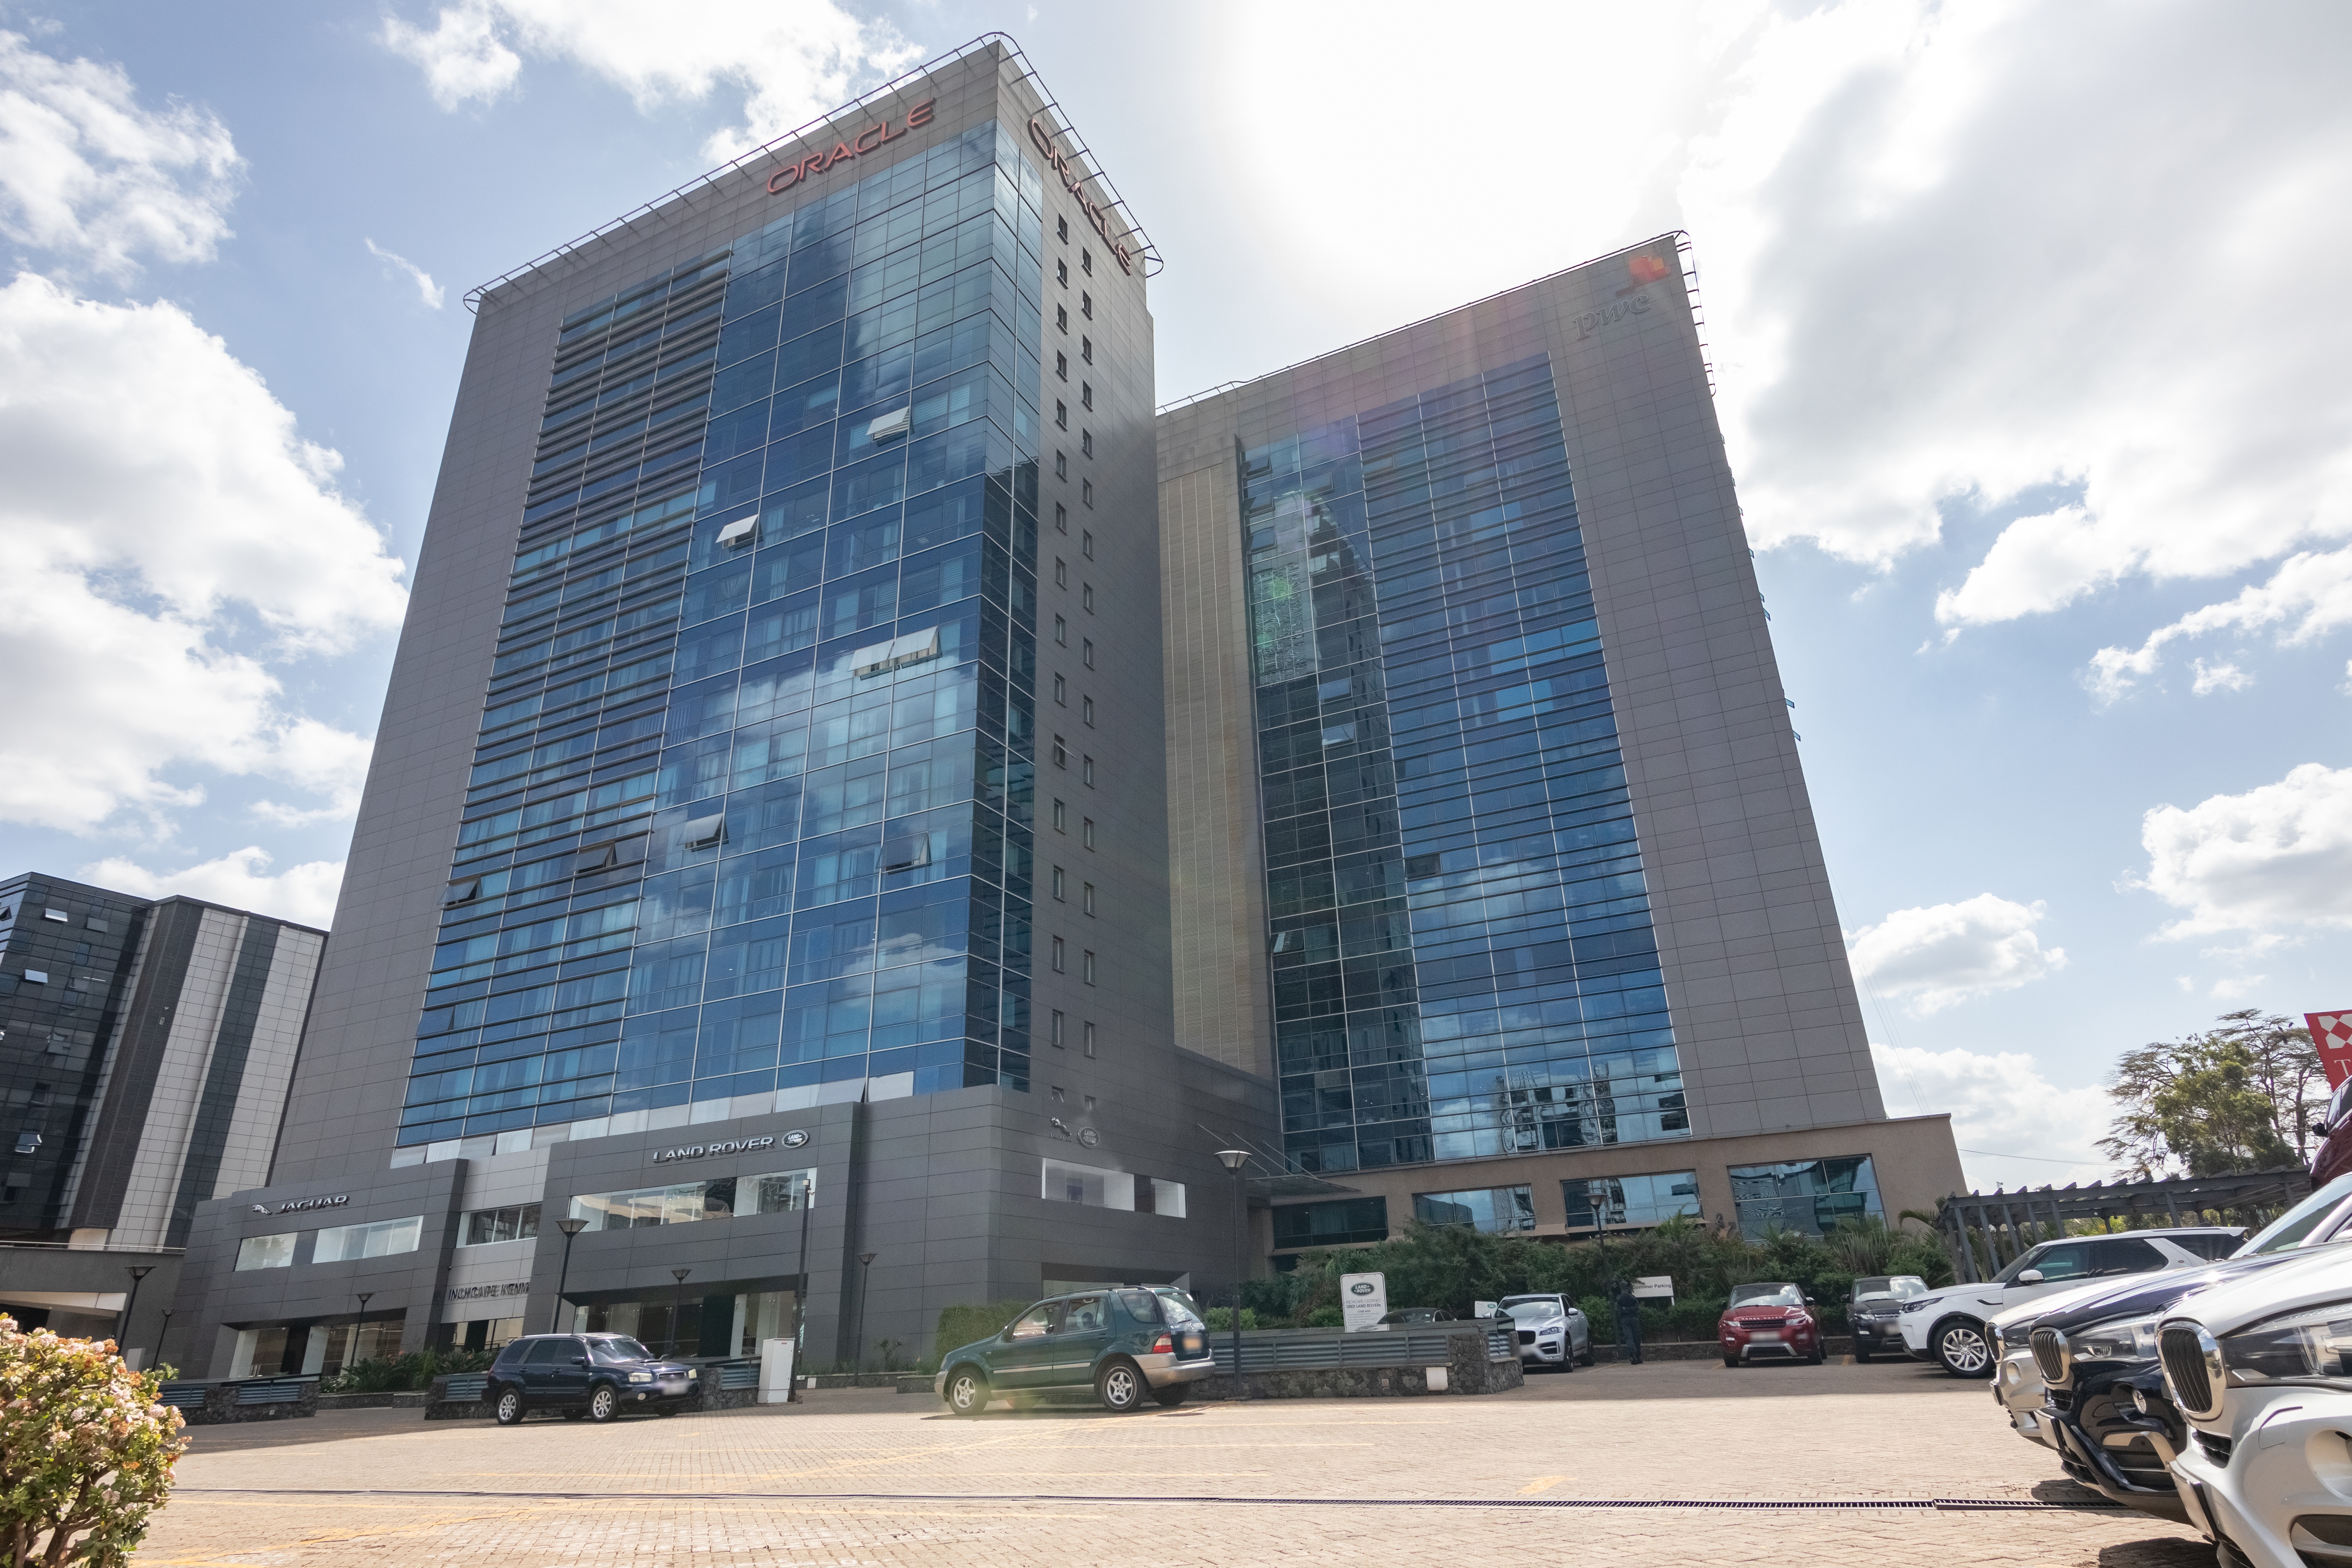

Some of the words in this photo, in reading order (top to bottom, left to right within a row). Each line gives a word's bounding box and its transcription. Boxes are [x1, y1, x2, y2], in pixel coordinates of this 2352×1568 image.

[767, 97, 936, 195] ORACLE
[1028, 118, 1132, 276] ORACLE
[1573, 295, 1650, 340] pwc
[653, 1146, 705, 1163] LAND
[709, 1137, 774, 1156] ROVER
[275, 1195, 349, 1214] JAGUAR
[449, 1285, 499, 1300] INCHCAPE
[500, 1282, 530, 1296] KENY
